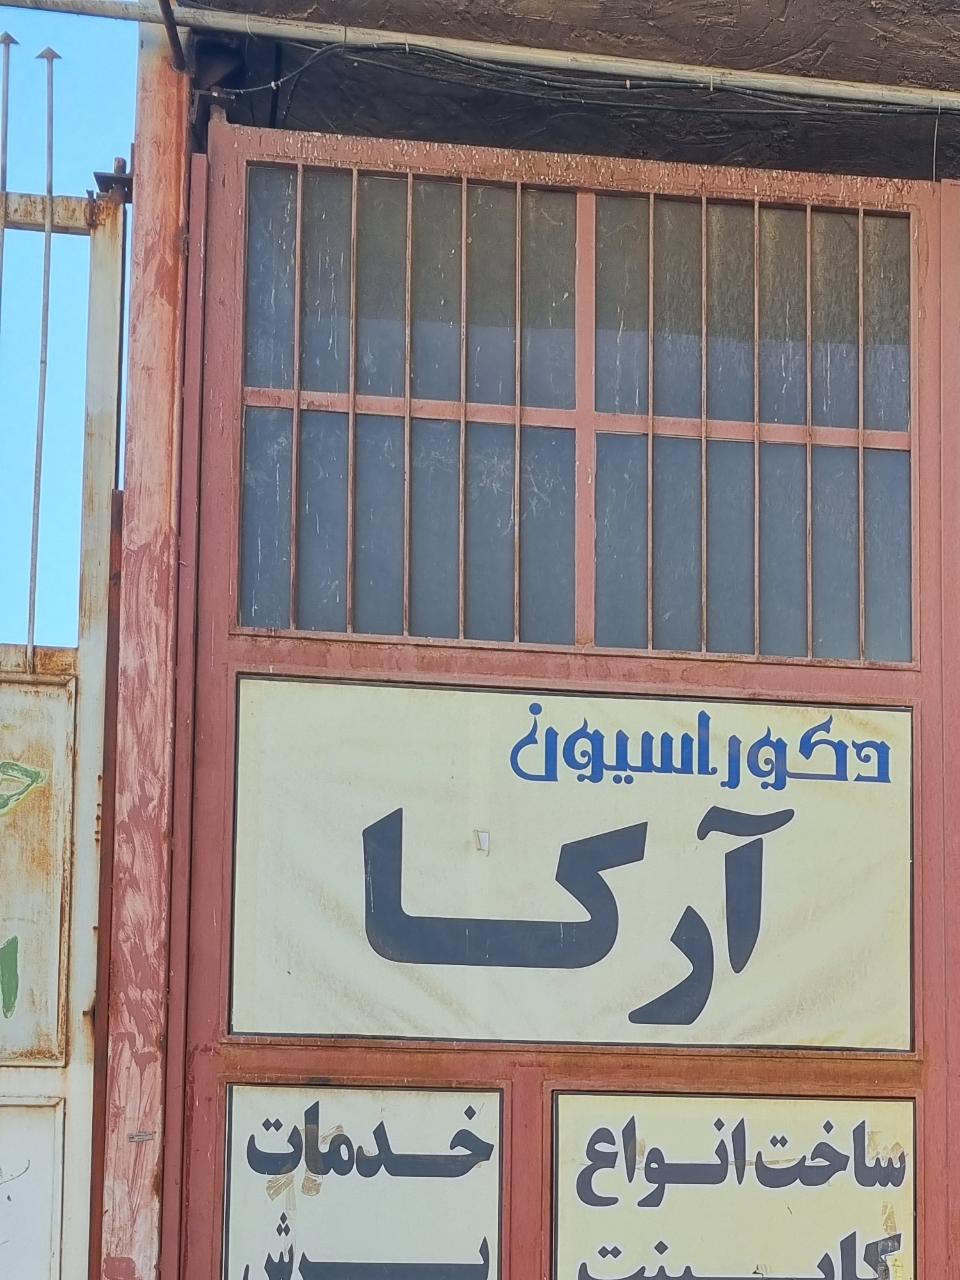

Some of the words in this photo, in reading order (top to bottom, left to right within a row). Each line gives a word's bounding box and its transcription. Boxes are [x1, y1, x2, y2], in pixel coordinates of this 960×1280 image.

[510, 702, 893, 790] دکوراسیون
[362, 805, 796, 1025] آرکا
[246, 1101, 494, 1178] خدمات
[575, 1115, 747, 1207] انواع
[755, 1119, 906, 1188] ساخت
